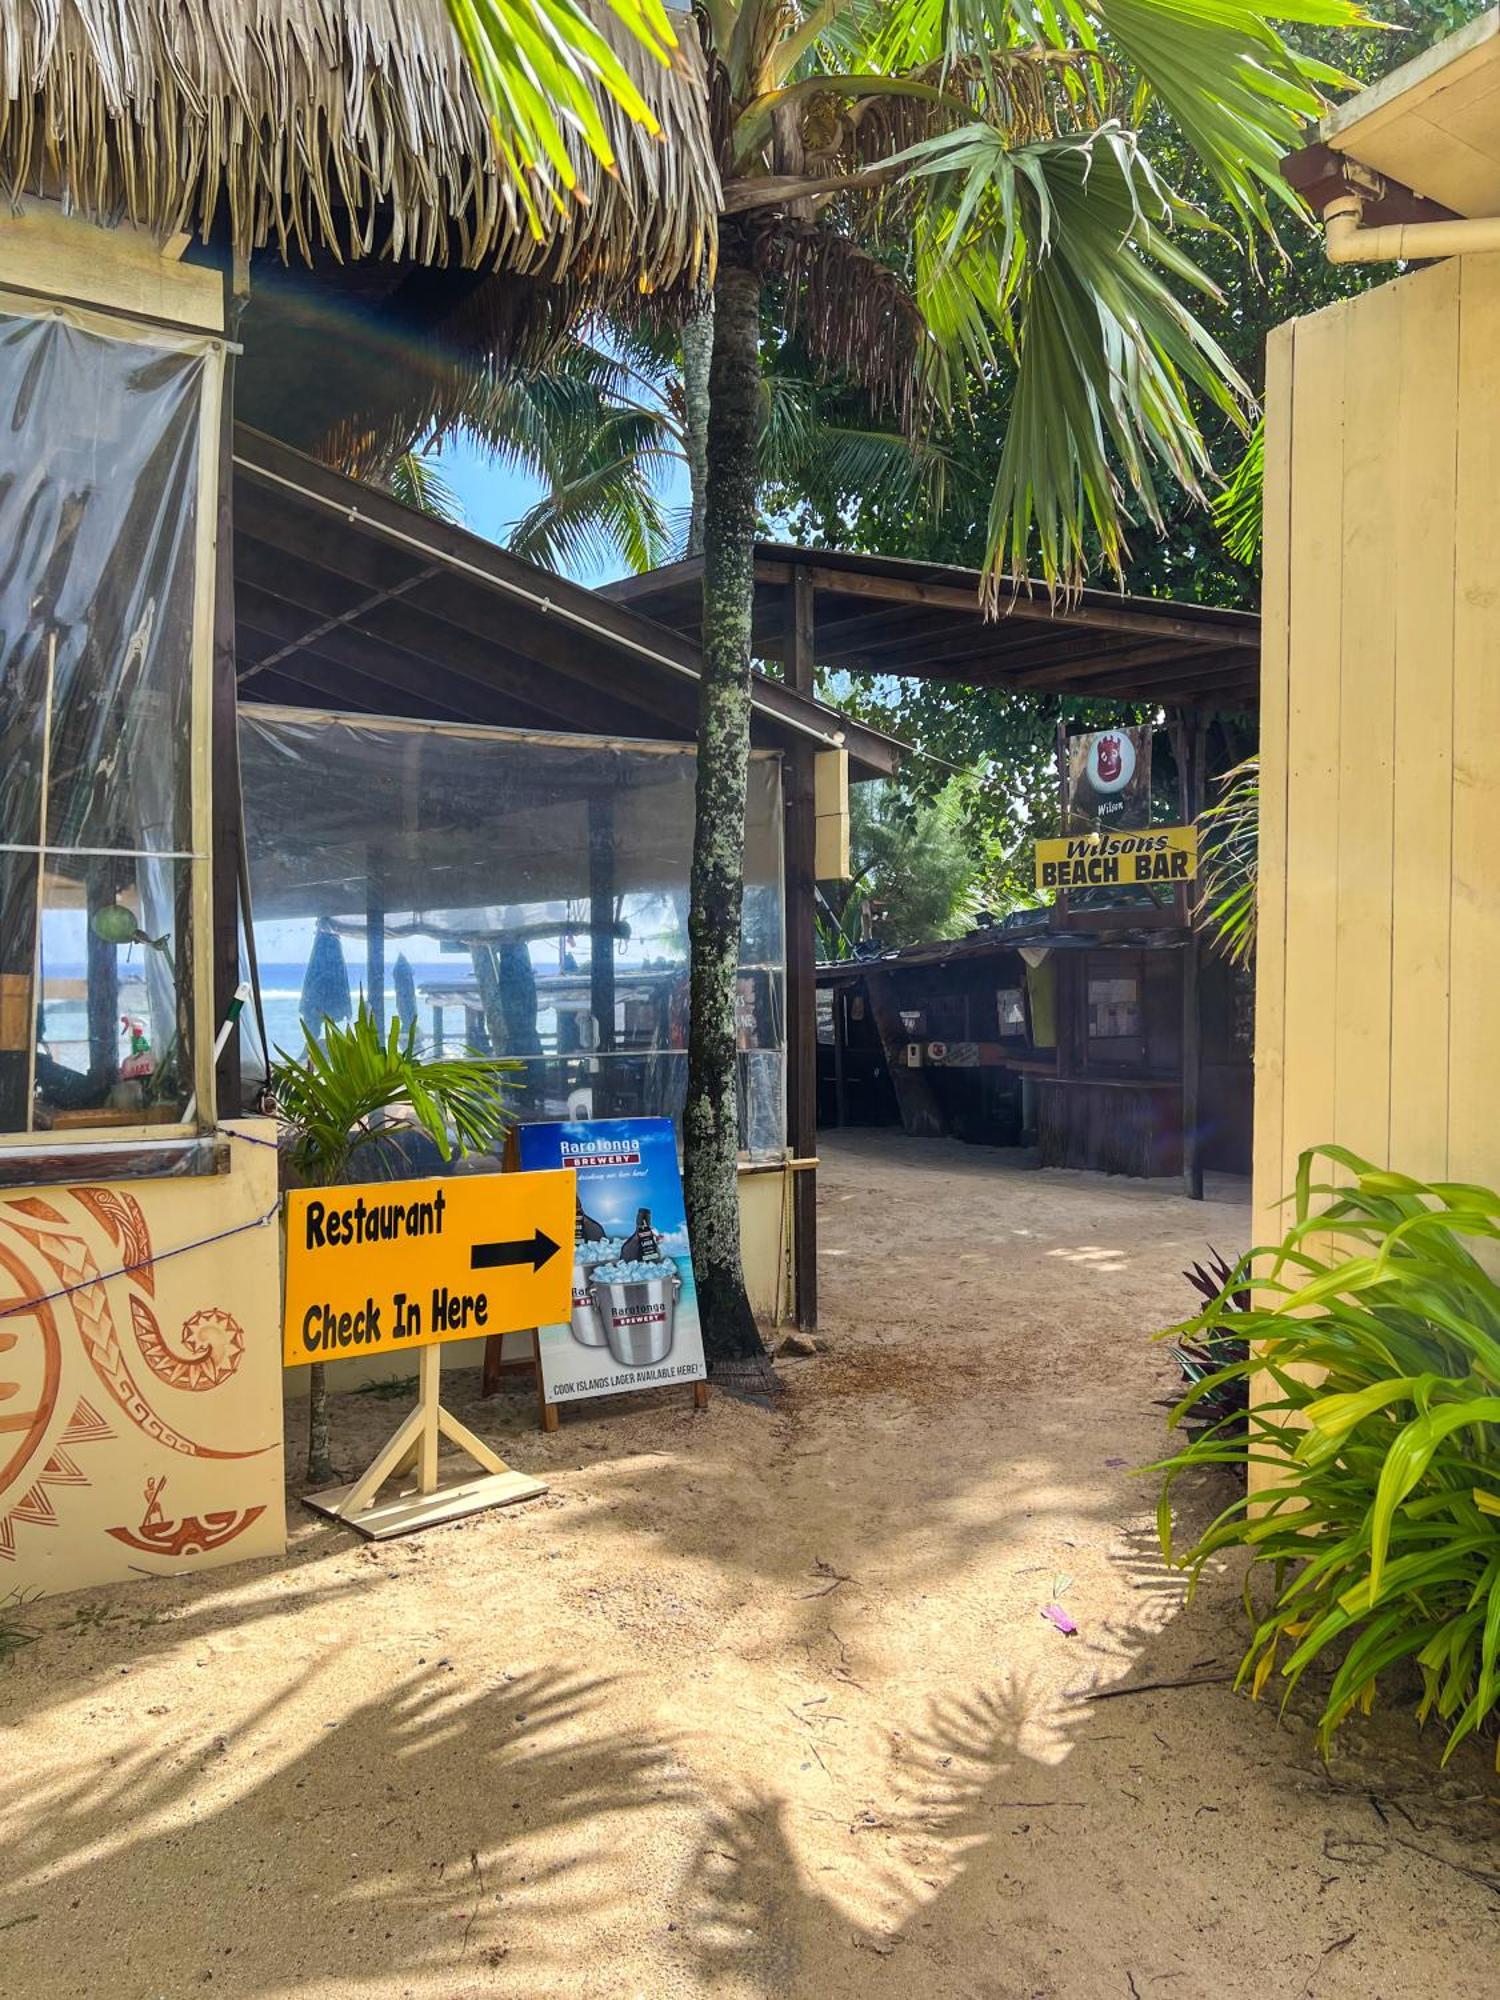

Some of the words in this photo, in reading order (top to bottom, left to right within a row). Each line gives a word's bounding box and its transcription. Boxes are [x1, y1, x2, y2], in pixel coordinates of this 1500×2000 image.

[1067, 835, 1169, 858] Wilsons
[1042, 857, 1119, 887] BEACH
[1135, 852, 1188, 881] BAR
[560, 1139, 640, 1155] Rarotonga
[574, 1155, 630, 1166] BREWERY
[306, 1189, 446, 1250] Restaurant
[303, 1298, 381, 1351] Check
[392, 1293, 421, 1339] In
[431, 1287, 488, 1332] Here
[611, 1304, 666, 1316] Rarotonga
[553, 1382, 576, 1396] COOK
[576, 1377, 610, 1392] ISLANDS
[610, 1373, 636, 1387] LAGER
[637, 1367, 676, 1383] AVAILABLE
[677, 1363, 699, 1376] HERE!
